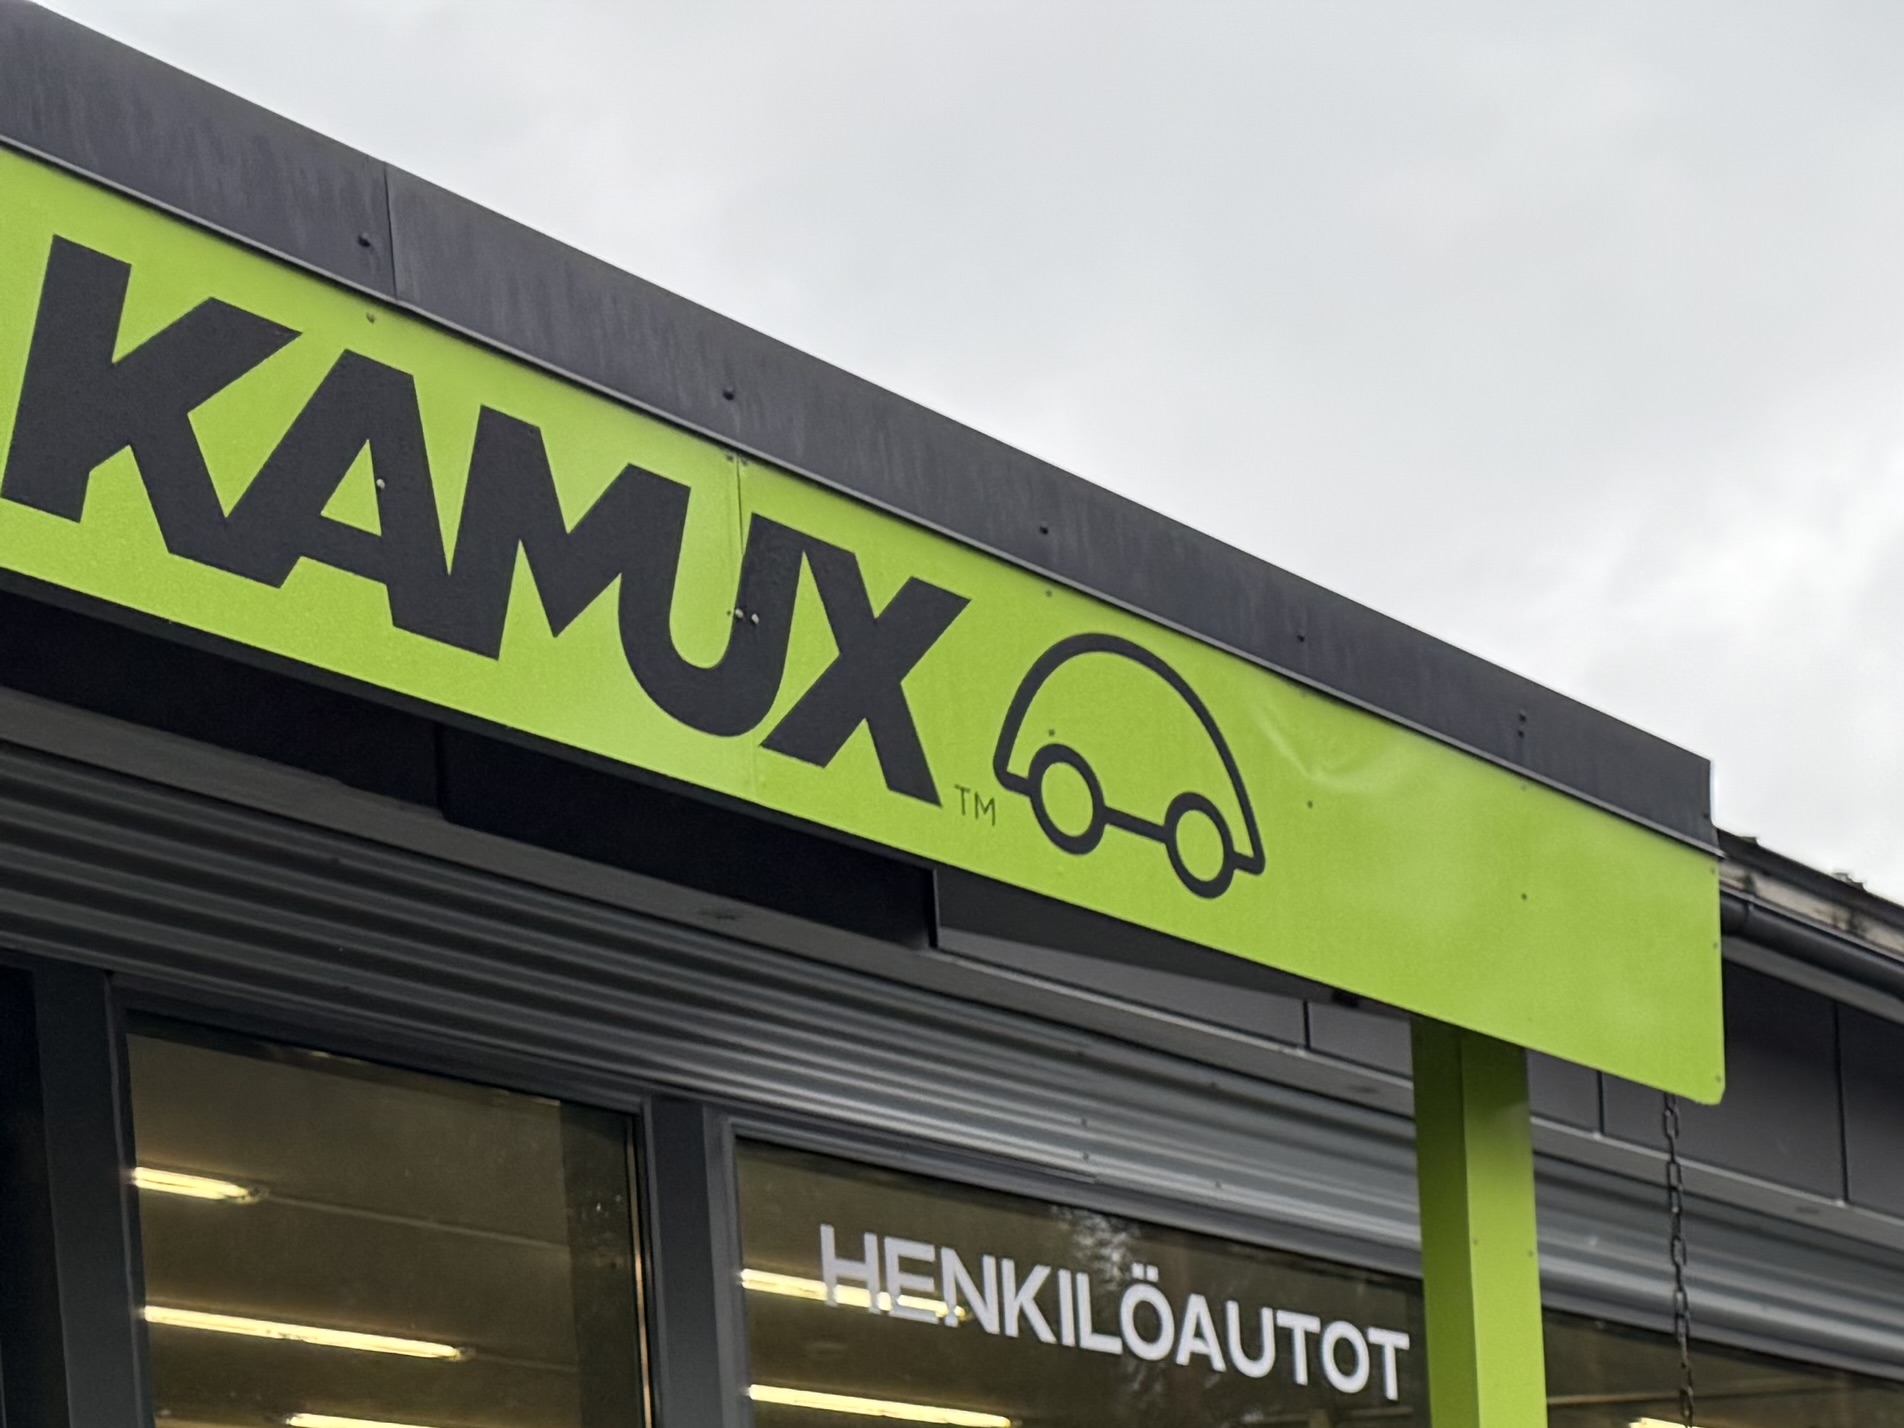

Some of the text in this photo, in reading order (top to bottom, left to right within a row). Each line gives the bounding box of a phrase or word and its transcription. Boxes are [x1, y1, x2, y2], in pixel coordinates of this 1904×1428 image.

[0, 234, 996, 827] KAMUX TM
[820, 1224, 1410, 1400] HENKILÖAUTOT
